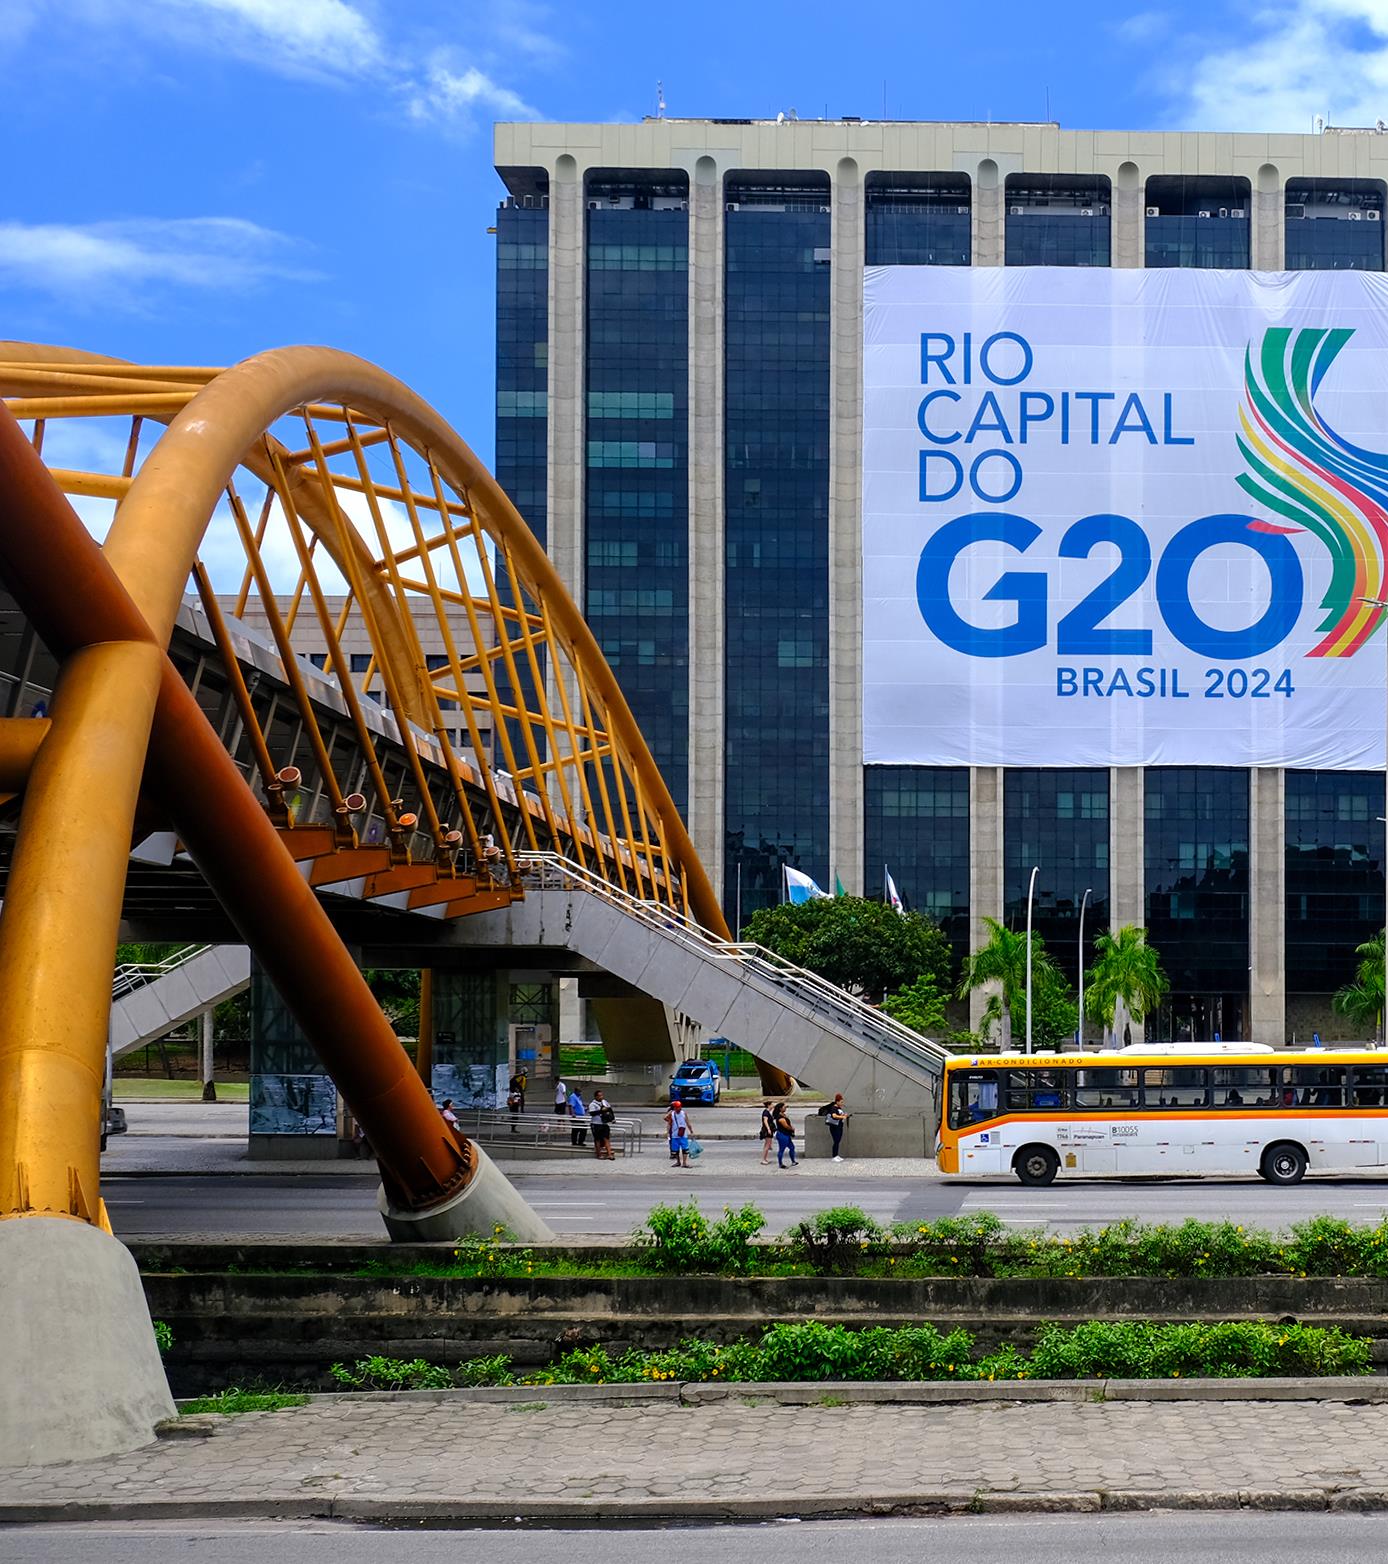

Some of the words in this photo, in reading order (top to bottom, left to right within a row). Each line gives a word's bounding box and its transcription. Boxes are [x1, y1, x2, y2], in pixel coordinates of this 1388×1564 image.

[920, 331, 1033, 386] RIO
[917, 389, 1195, 445] CAPITAL
[918, 448, 1023, 504] DO
[915, 511, 1304, 660] G20
[1056, 667, 1190, 698] BRASIL
[1204, 668, 1296, 698] 2024
